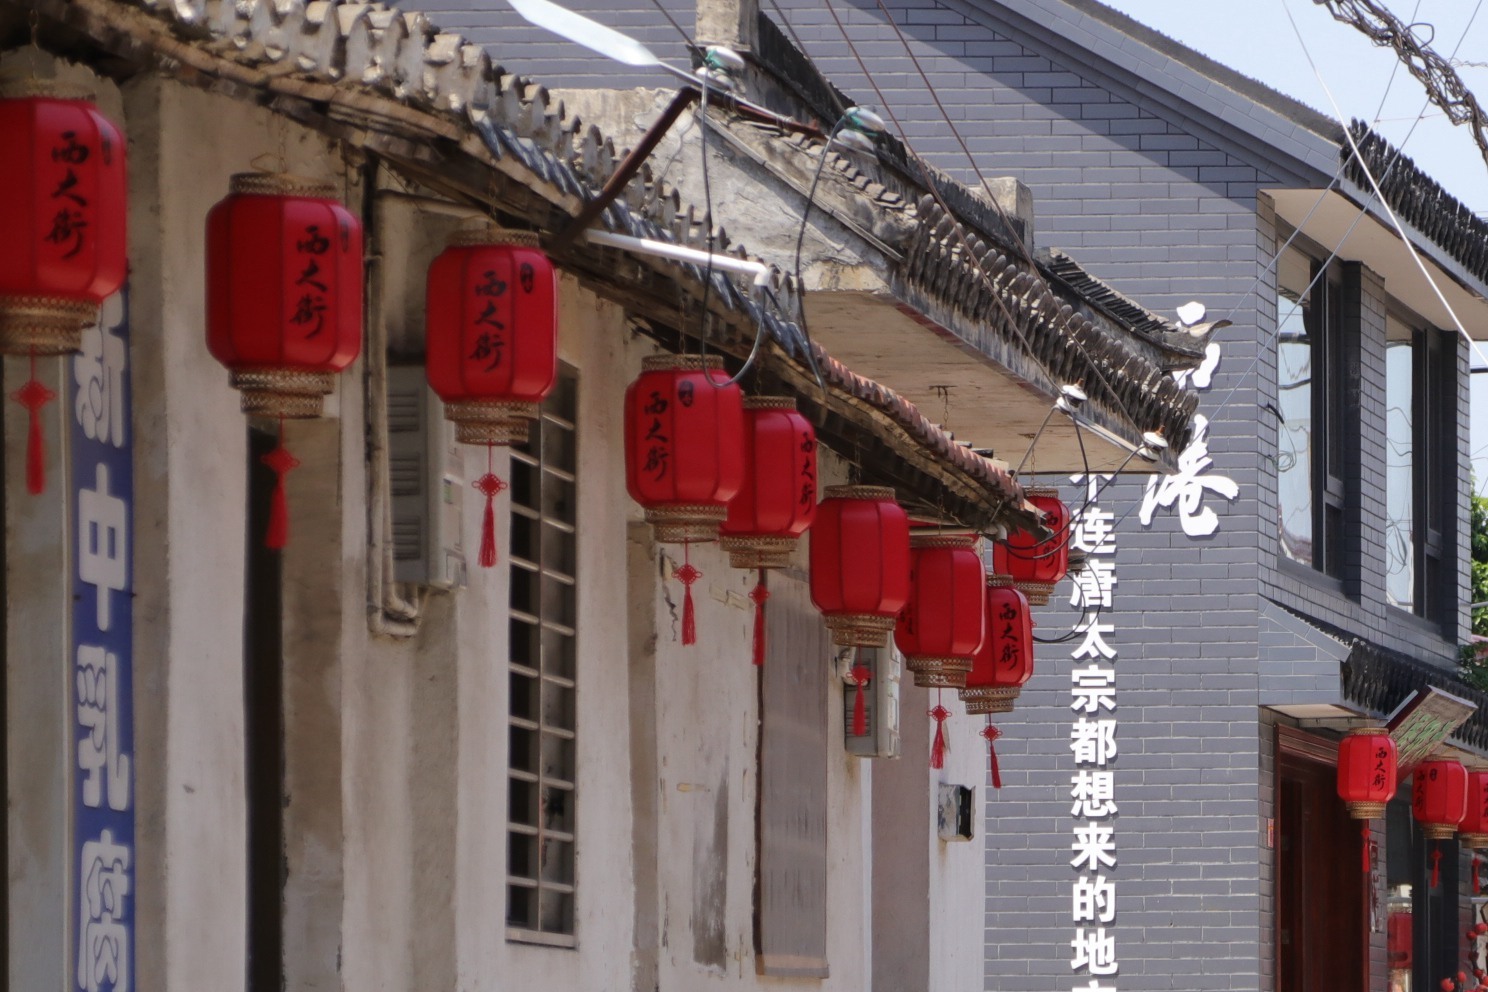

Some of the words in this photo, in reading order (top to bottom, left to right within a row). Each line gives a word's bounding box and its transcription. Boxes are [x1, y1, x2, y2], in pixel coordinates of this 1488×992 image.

[44, 131, 89, 260] 西大街
[289, 224, 331, 340] 西大街
[468, 269, 508, 372] 西大街
[642, 391, 672, 482] 西大街
[800, 431, 814, 516] 西大街
[998, 602, 1020, 672] 西大街
[1372, 746, 1388, 791] 西大街
[1415, 769, 1426, 813] 西大街
